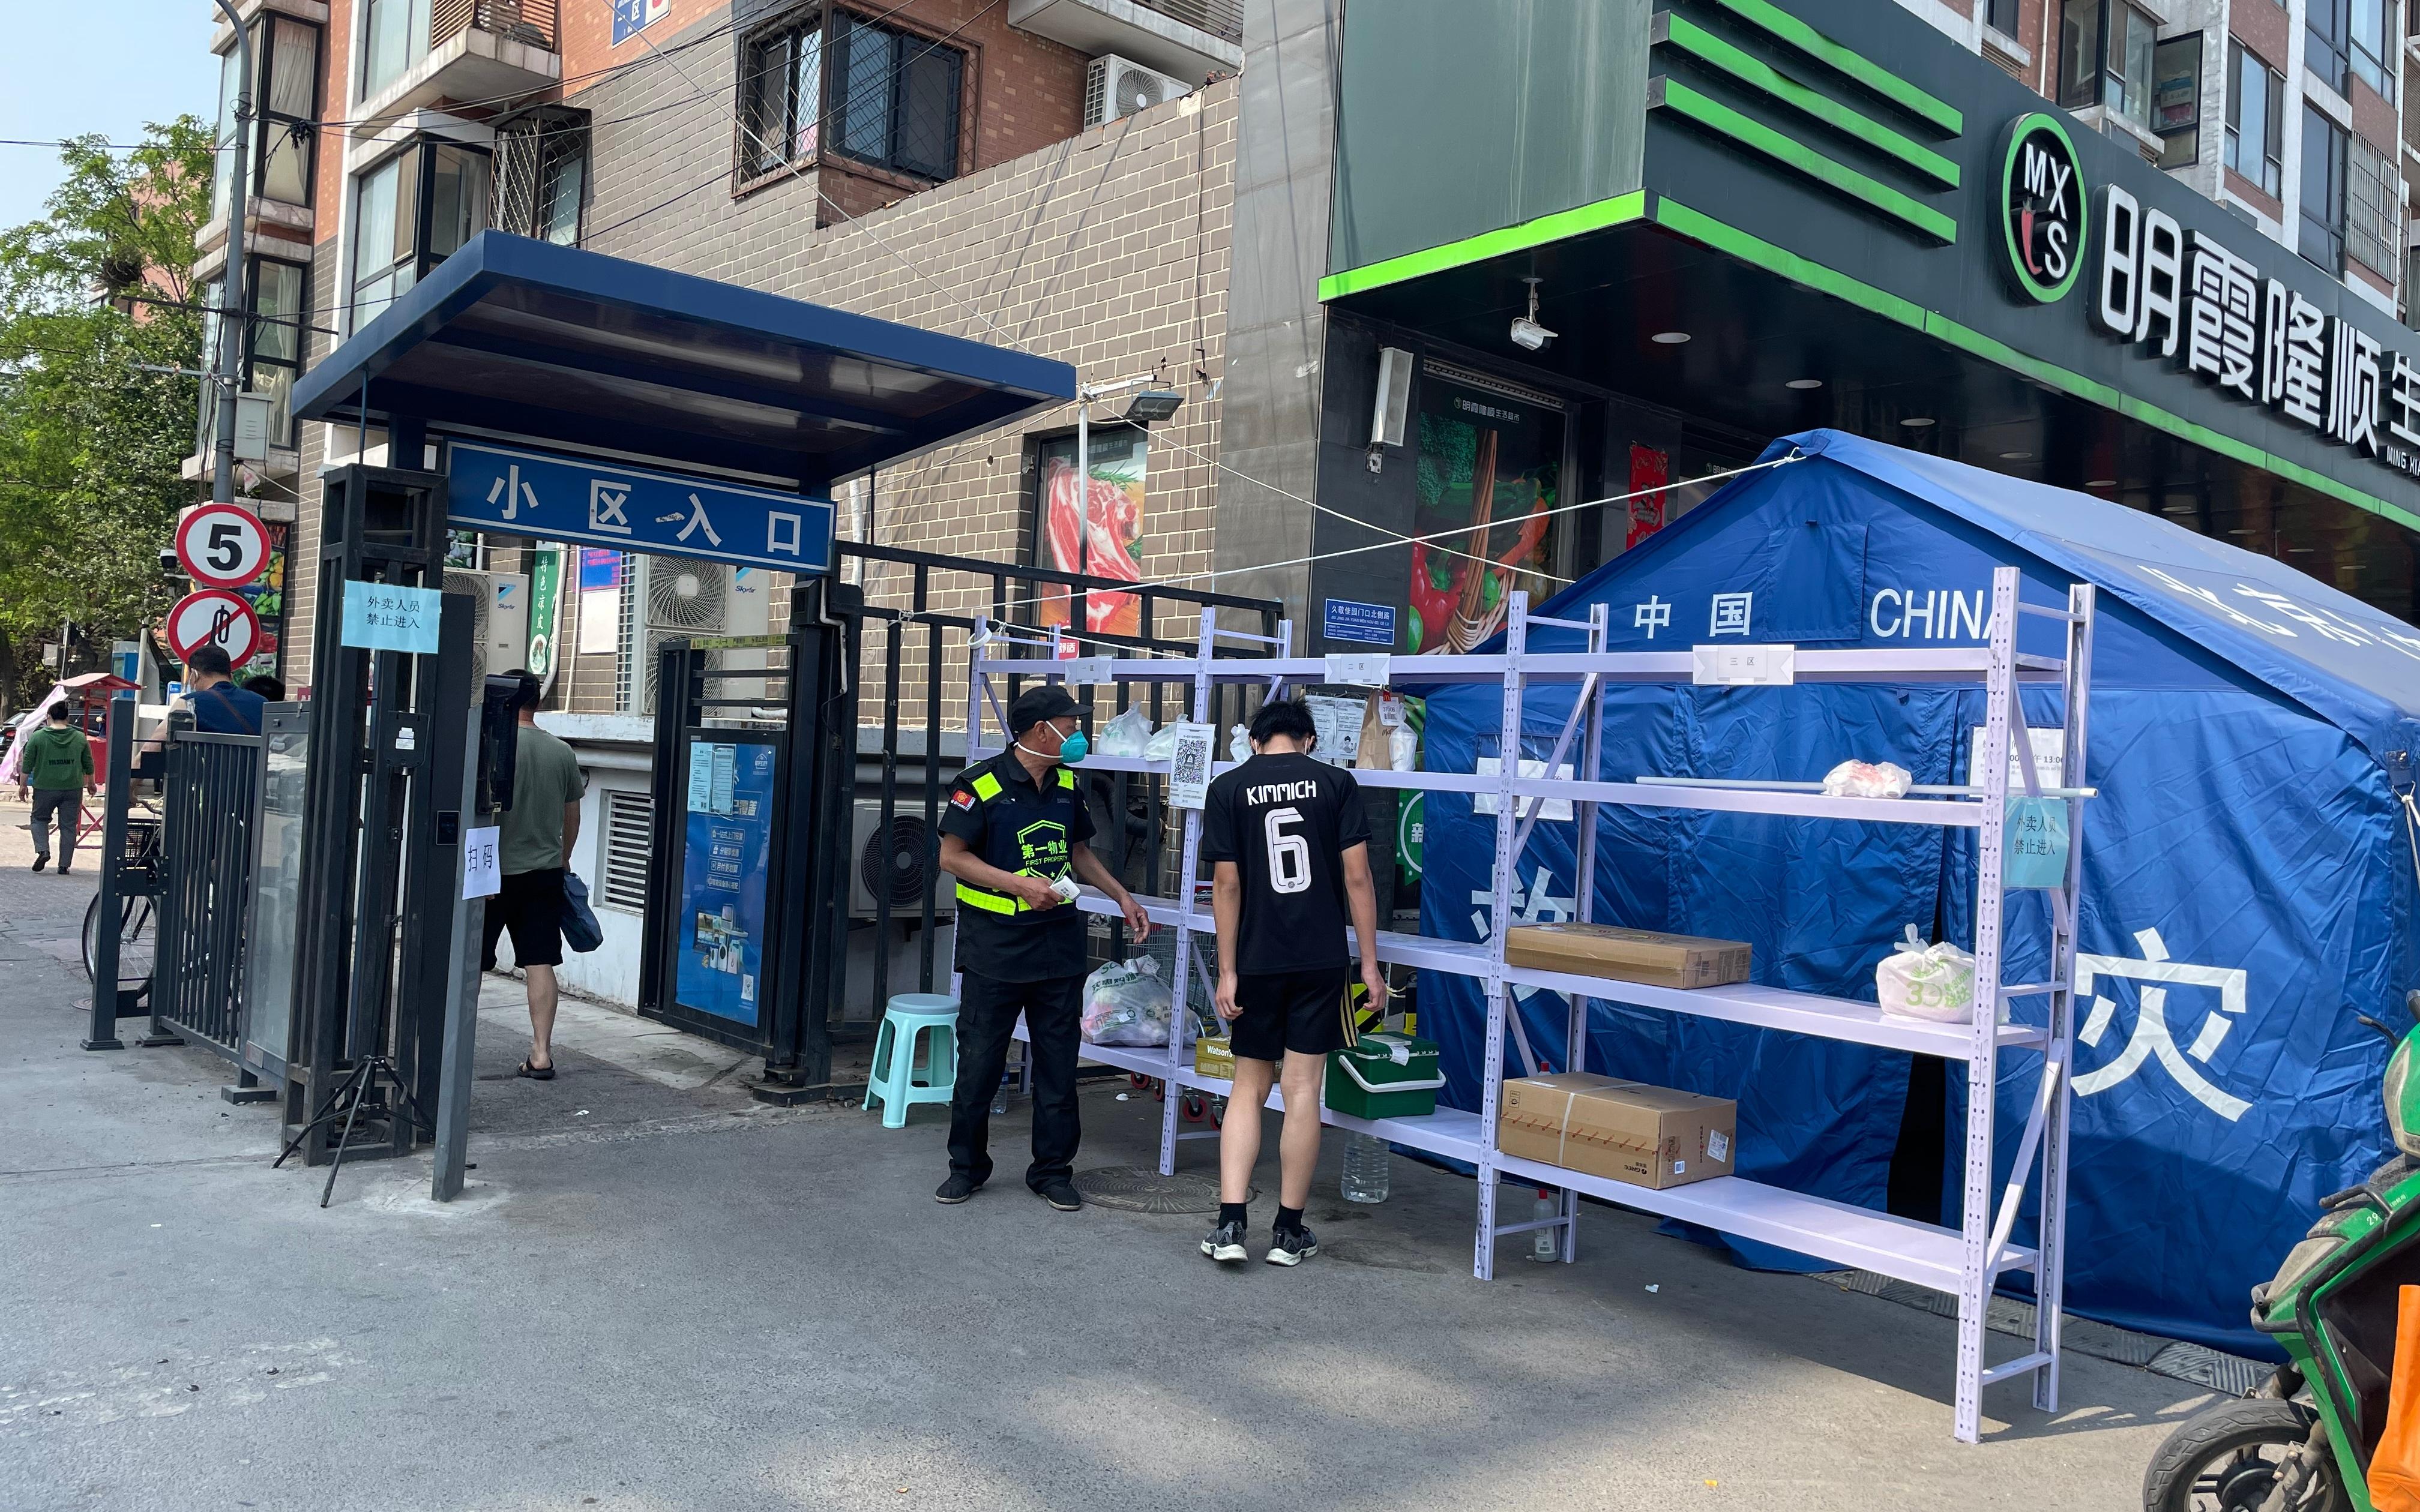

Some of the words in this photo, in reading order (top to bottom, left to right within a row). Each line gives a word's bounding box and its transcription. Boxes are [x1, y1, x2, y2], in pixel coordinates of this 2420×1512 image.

[2386, 445, 2406, 469] MING
[487, 464, 801, 556] 小区入口
[206, 523, 242, 571] 5
[367, 596, 420, 613] 外卖人员
[1634, 592, 1752, 639] 中国
[1870, 587, 1993, 640] CHIN
[366, 613, 420, 629] 禁止进入
[1729, 656, 1755, 666] 三区
[1247, 780, 1316, 806] KIMMICH
[2017, 814, 2056, 833] 外卖人员
[1022, 839, 1068, 859] 第一物业
[1265, 807, 1311, 894] 6
[2014, 837, 2056, 856] 禁止进入
[468, 844, 493, 872] 扫码
[1026, 858, 1043, 866] FIRST
[1044, 855, 1068, 863] PROPERTY
[1207, 1045, 1233, 1058] Watson's
